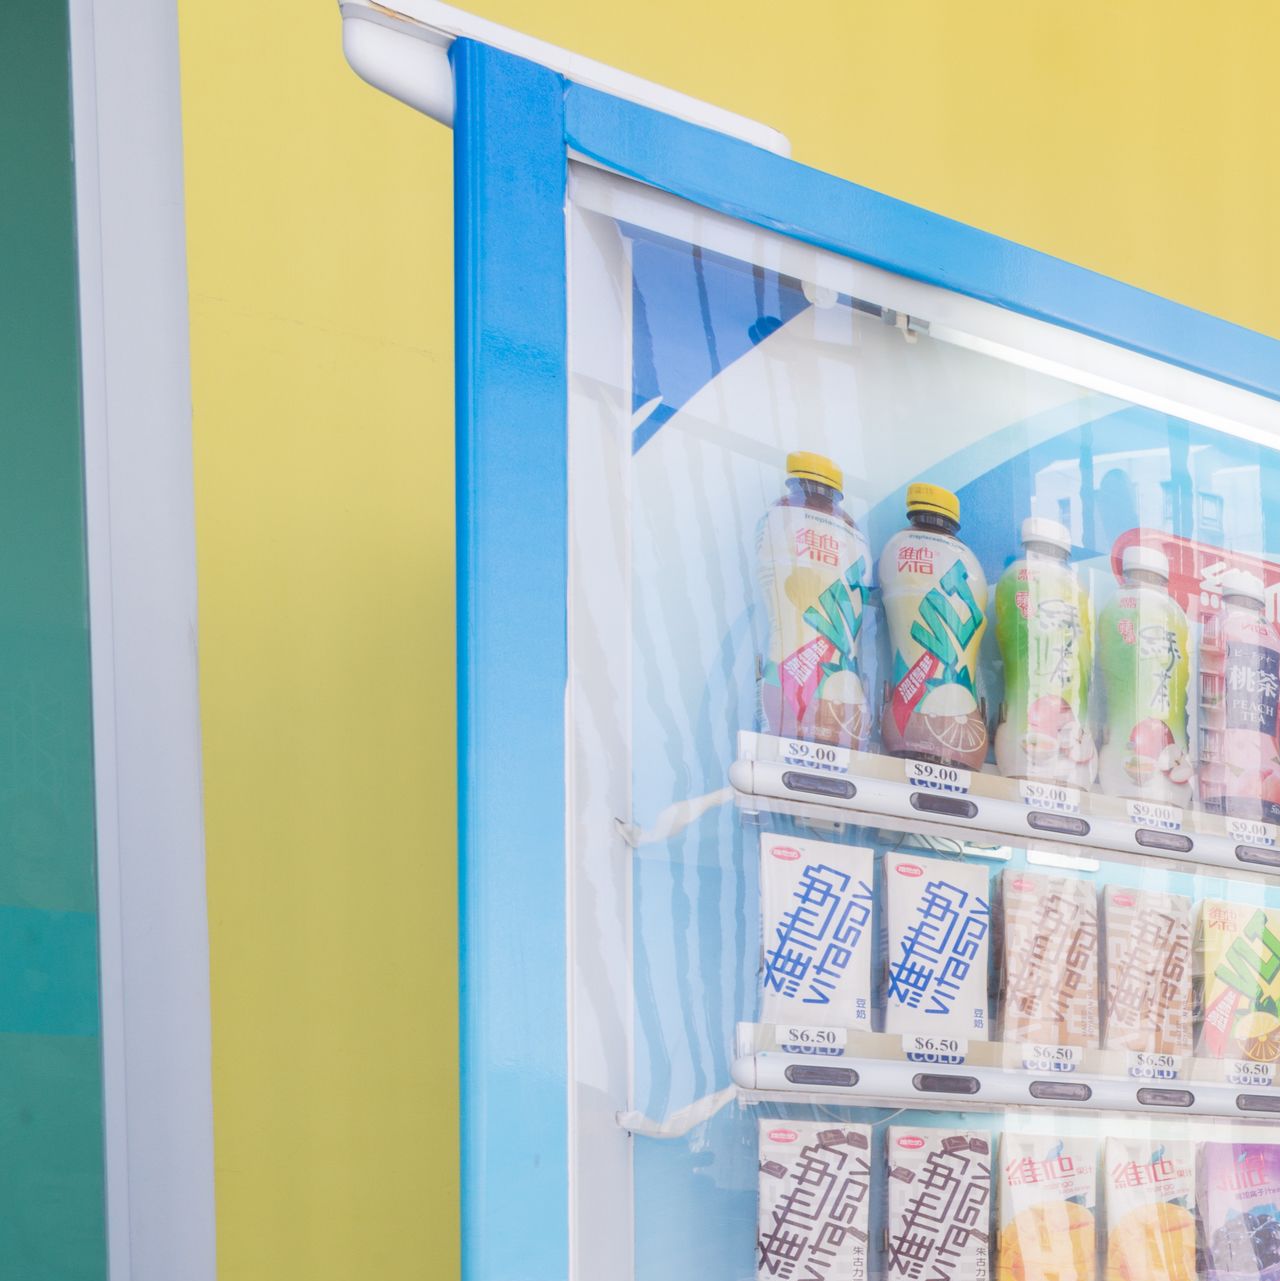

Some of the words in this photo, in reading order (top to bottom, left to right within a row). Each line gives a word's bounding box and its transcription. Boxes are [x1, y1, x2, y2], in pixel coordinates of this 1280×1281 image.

[1229, 666, 1279, 698] 桃茶
[1232, 700, 1274, 718] PEACH
[1240, 711, 1266, 726] TEA
[788, 742, 837, 764] $9.00
[913, 763, 958, 783] $9.00
[1025, 784, 1068, 802] $9.00
[1132, 803, 1171, 820] $9.00
[1231, 820, 1268, 836] $9.00
[764, 864, 851, 999] 維他奶
[888, 880, 969, 1008] 維他奶
[856, 999, 867, 1019] 豆奶
[973, 1008, 984, 1029] 豆奶
[789, 1028, 837, 1046] $6.50
[914, 1036, 959, 1053] $6.50
[1033, 1046, 1073, 1061] $6.50
[1137, 1052, 1175, 1068] $6.50
[1234, 1062, 1270, 1077] $6.50
[1005, 1155, 1075, 1188] 維他
[1111, 1158, 1175, 1188] 維他
[759, 1144, 848, 1281] 維他奶
[888, 1149, 972, 1280] 維他奶
